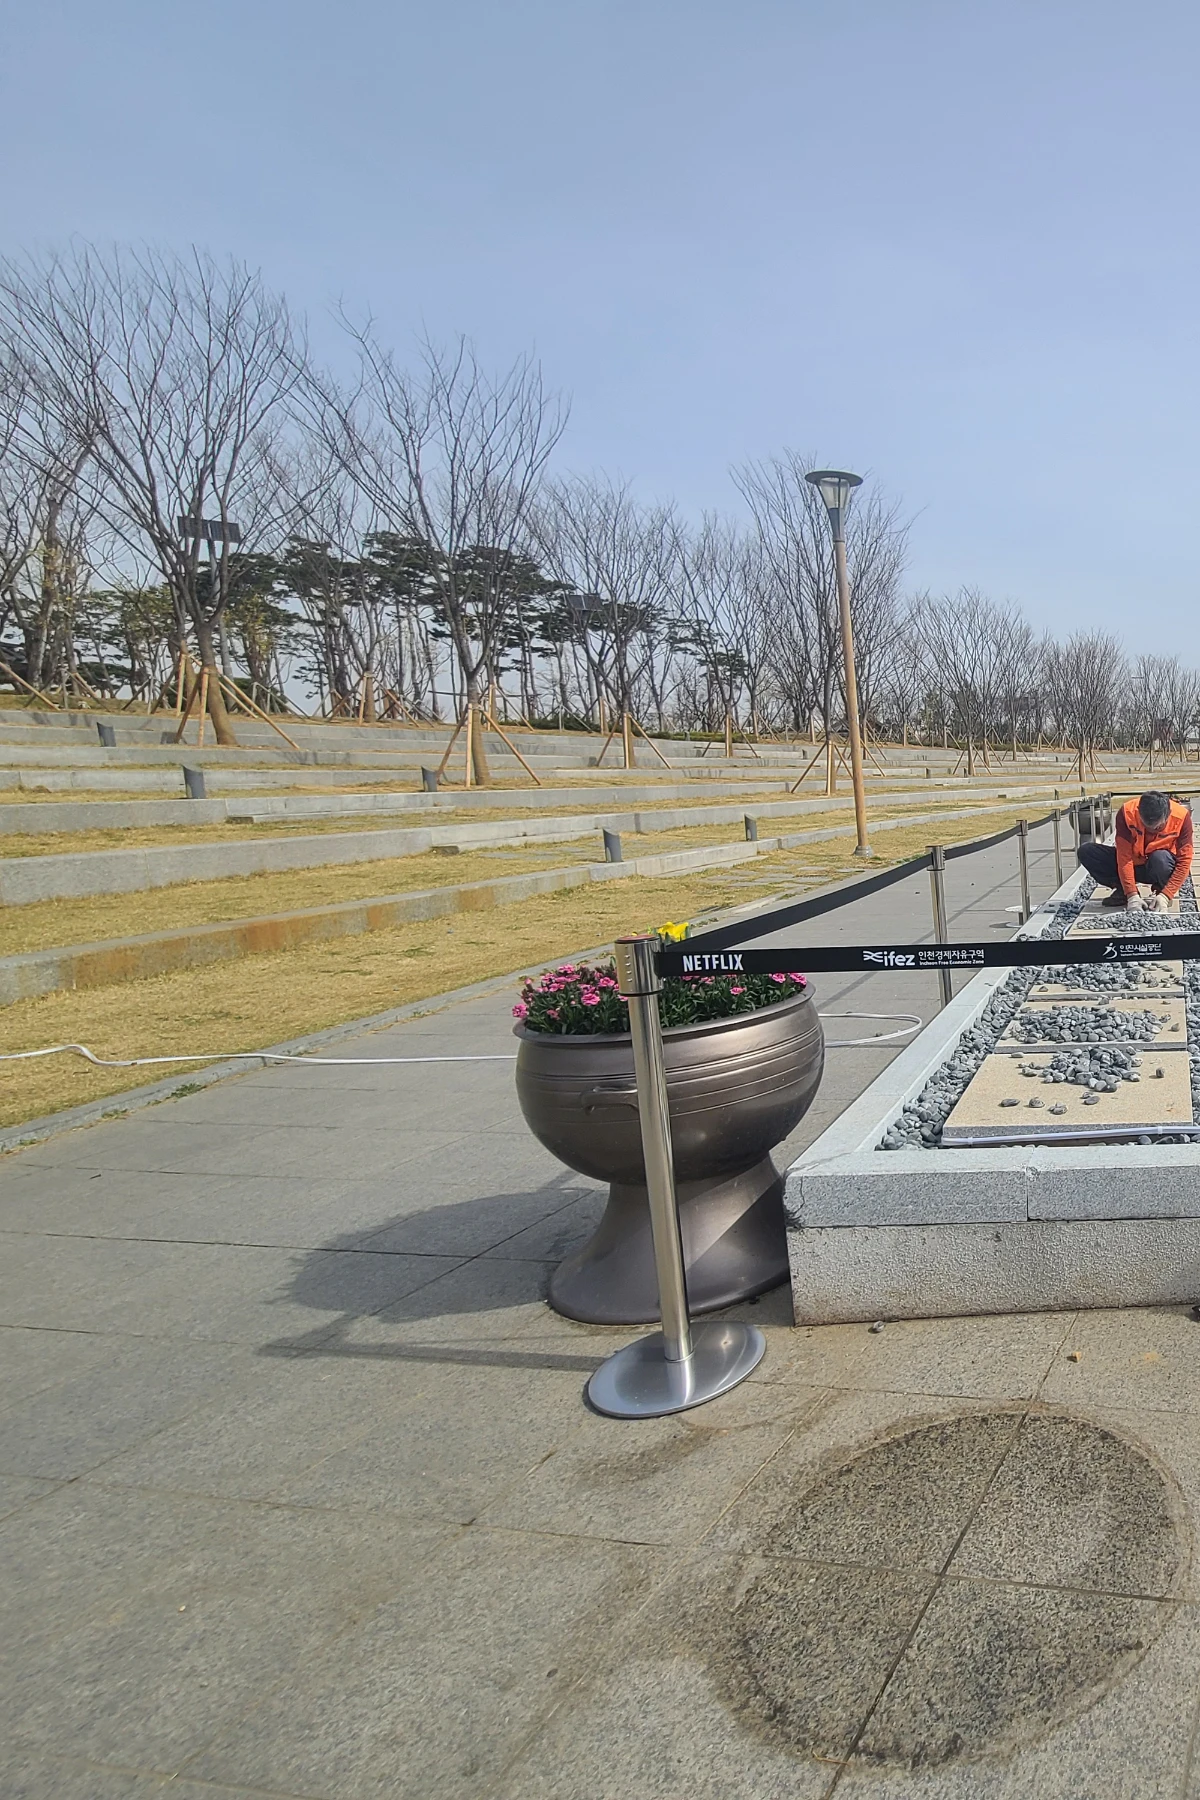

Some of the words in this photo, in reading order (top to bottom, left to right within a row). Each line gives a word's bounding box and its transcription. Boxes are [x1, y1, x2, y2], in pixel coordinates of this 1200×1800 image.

[884, 951, 915, 966] ifez
[918, 949, 984, 960] 인천경제자유구역
[682, 953, 744, 972] NETFLIX
